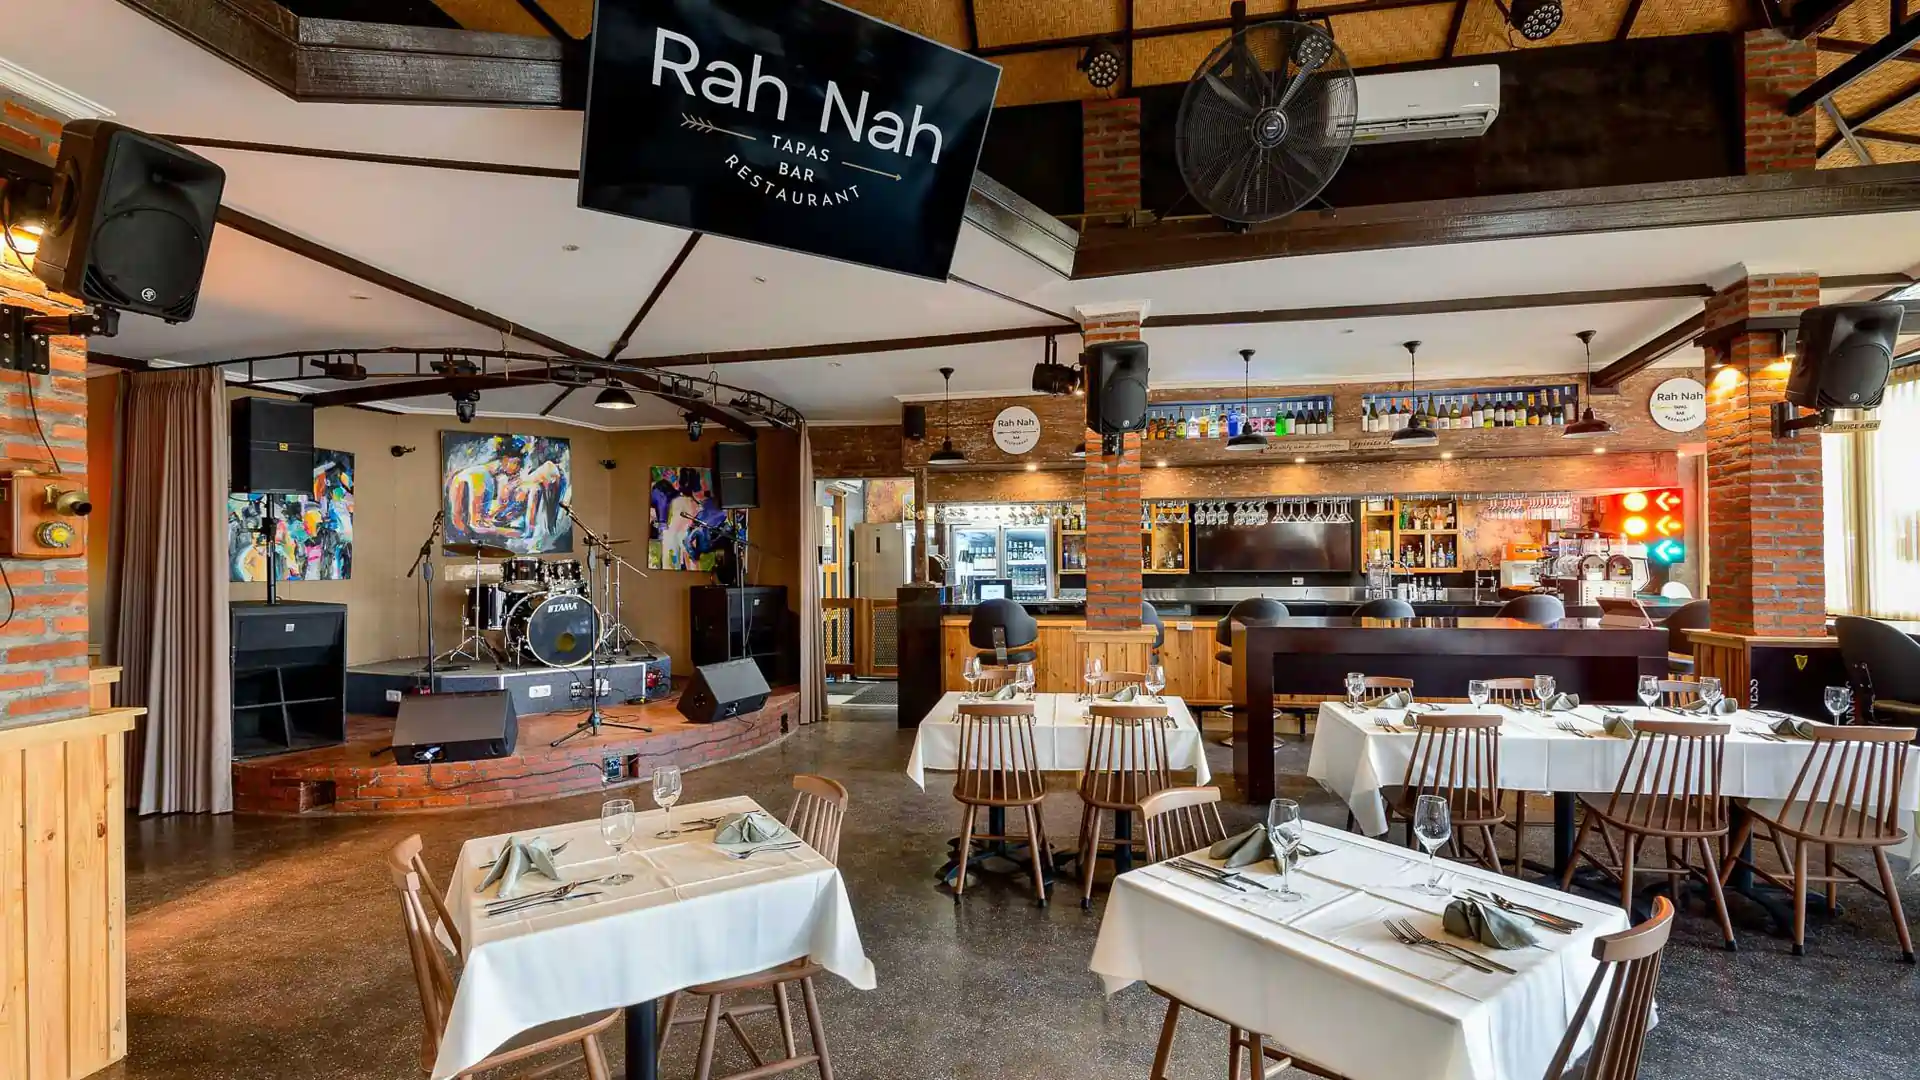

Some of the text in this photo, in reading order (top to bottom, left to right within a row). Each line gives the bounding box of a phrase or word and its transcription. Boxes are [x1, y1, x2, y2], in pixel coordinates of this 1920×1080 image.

[651, 26, 943, 164] Rah Nah
[771, 134, 830, 162] TAPAS
[724, 153, 860, 207] RESTAURANT
[778, 161, 815, 183] BAR
[1657, 392, 1703, 401] Rah Nah
[998, 418, 1035, 427] Rah Nah
